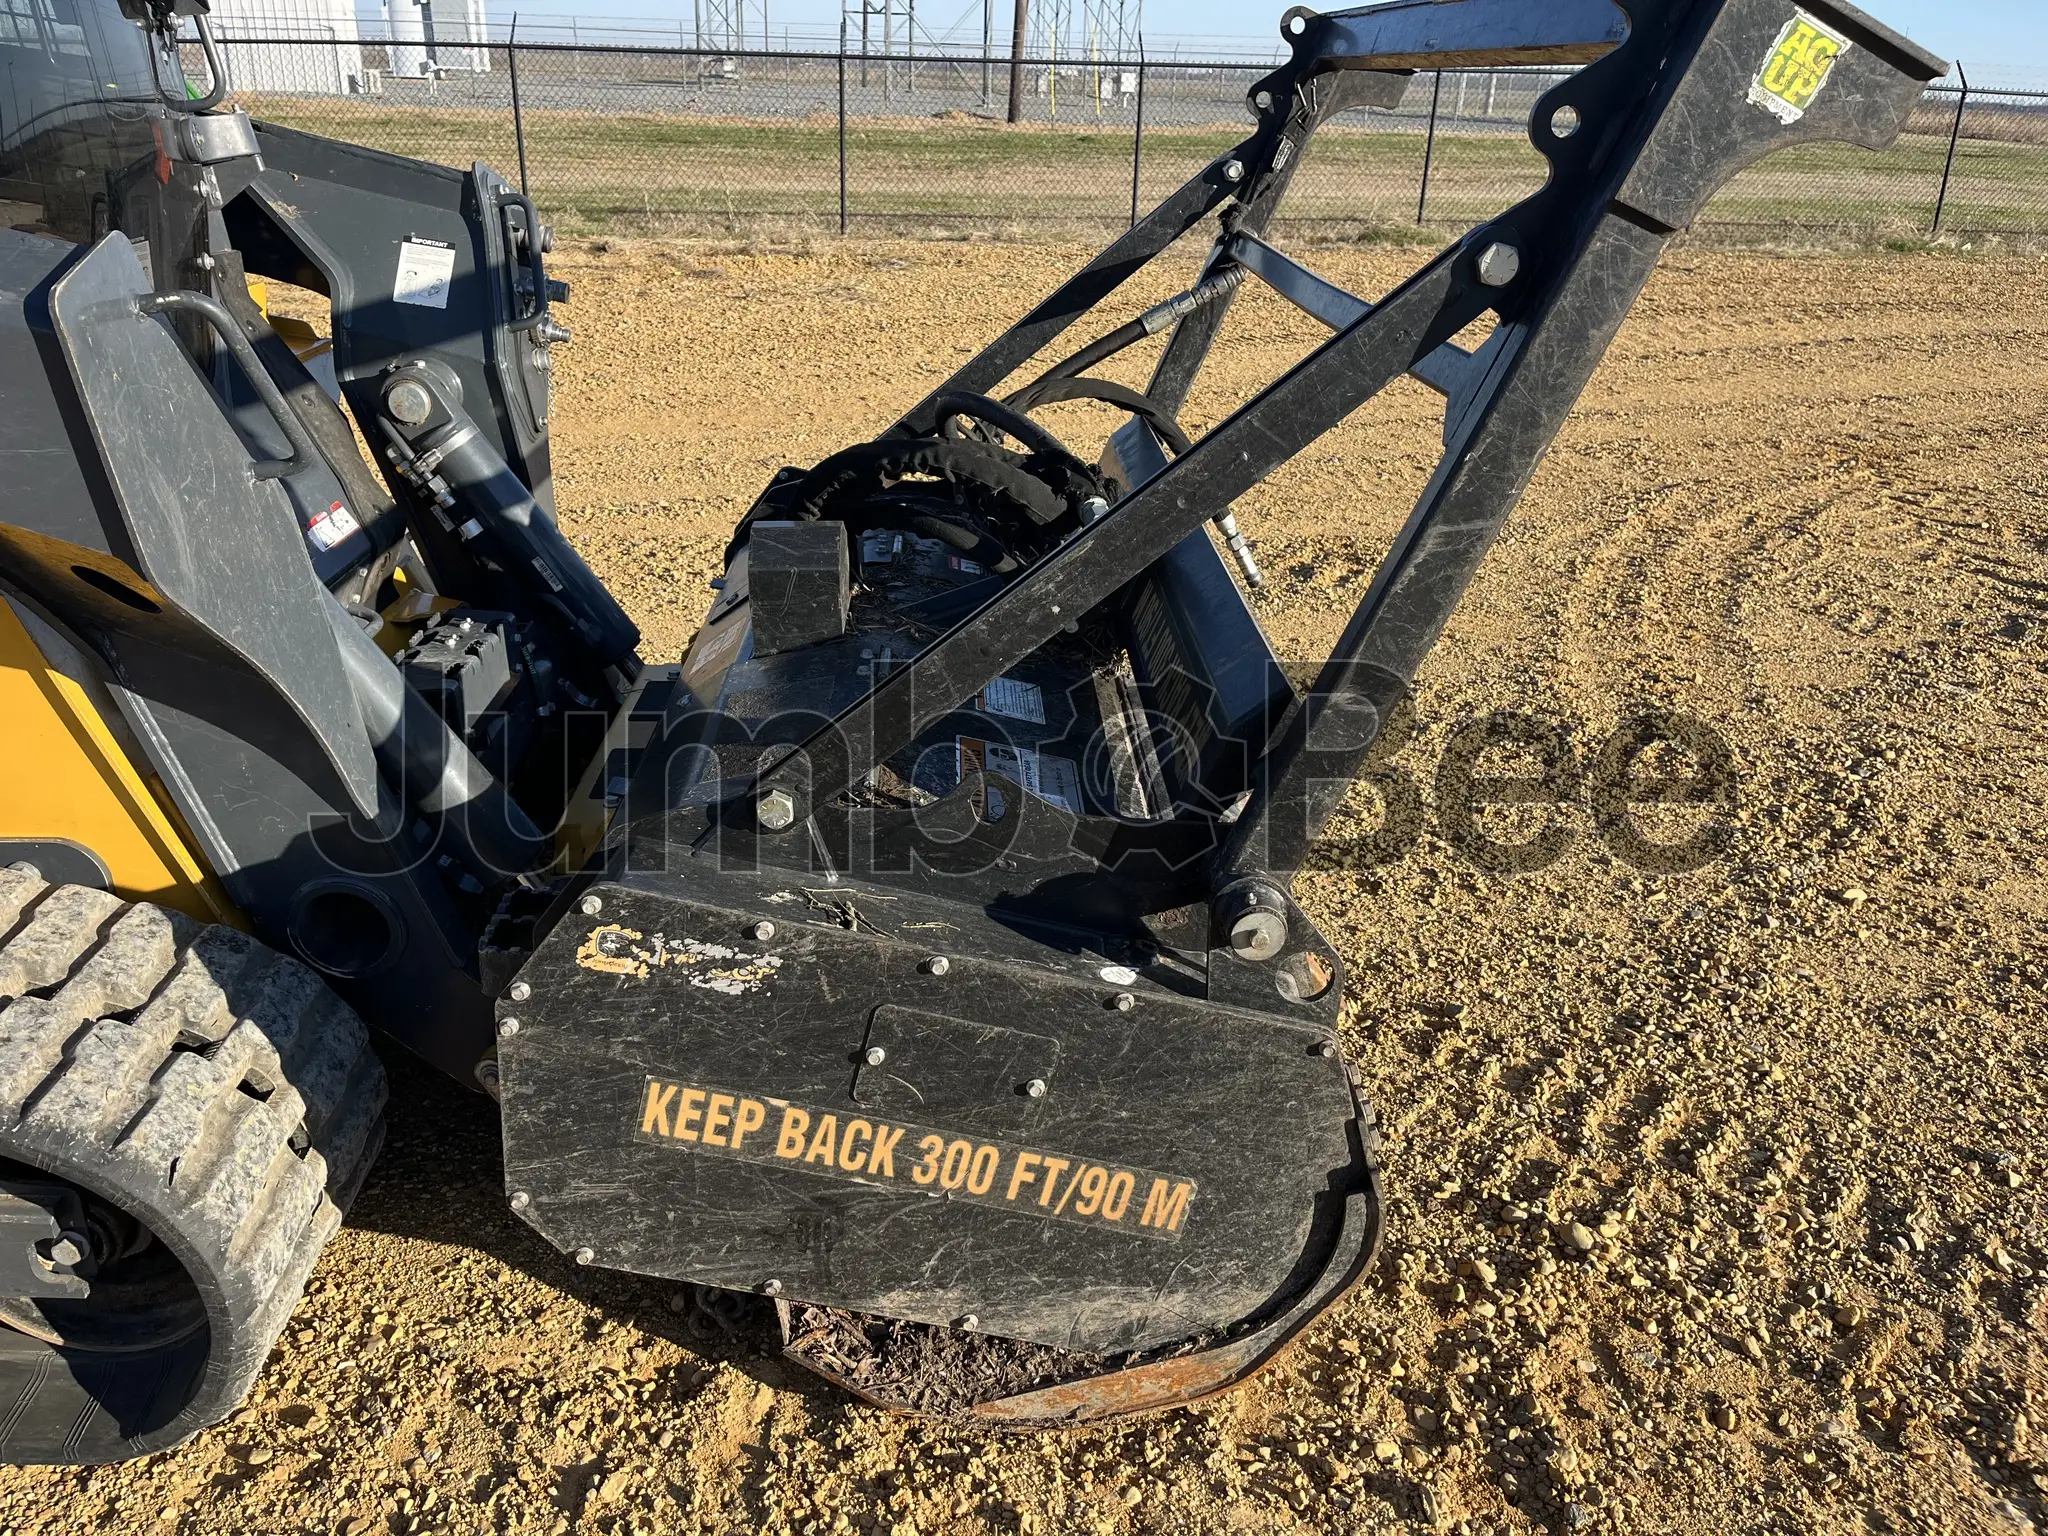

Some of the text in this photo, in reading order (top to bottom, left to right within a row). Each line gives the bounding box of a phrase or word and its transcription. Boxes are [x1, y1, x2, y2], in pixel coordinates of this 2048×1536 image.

[1780, 23, 1839, 75] AG
[1764, 55, 1818, 104] UP
[411, 236, 449, 248] IMPORTANT
[641, 1081, 1192, 1232] KEEP BACK 300 FT/90 M
